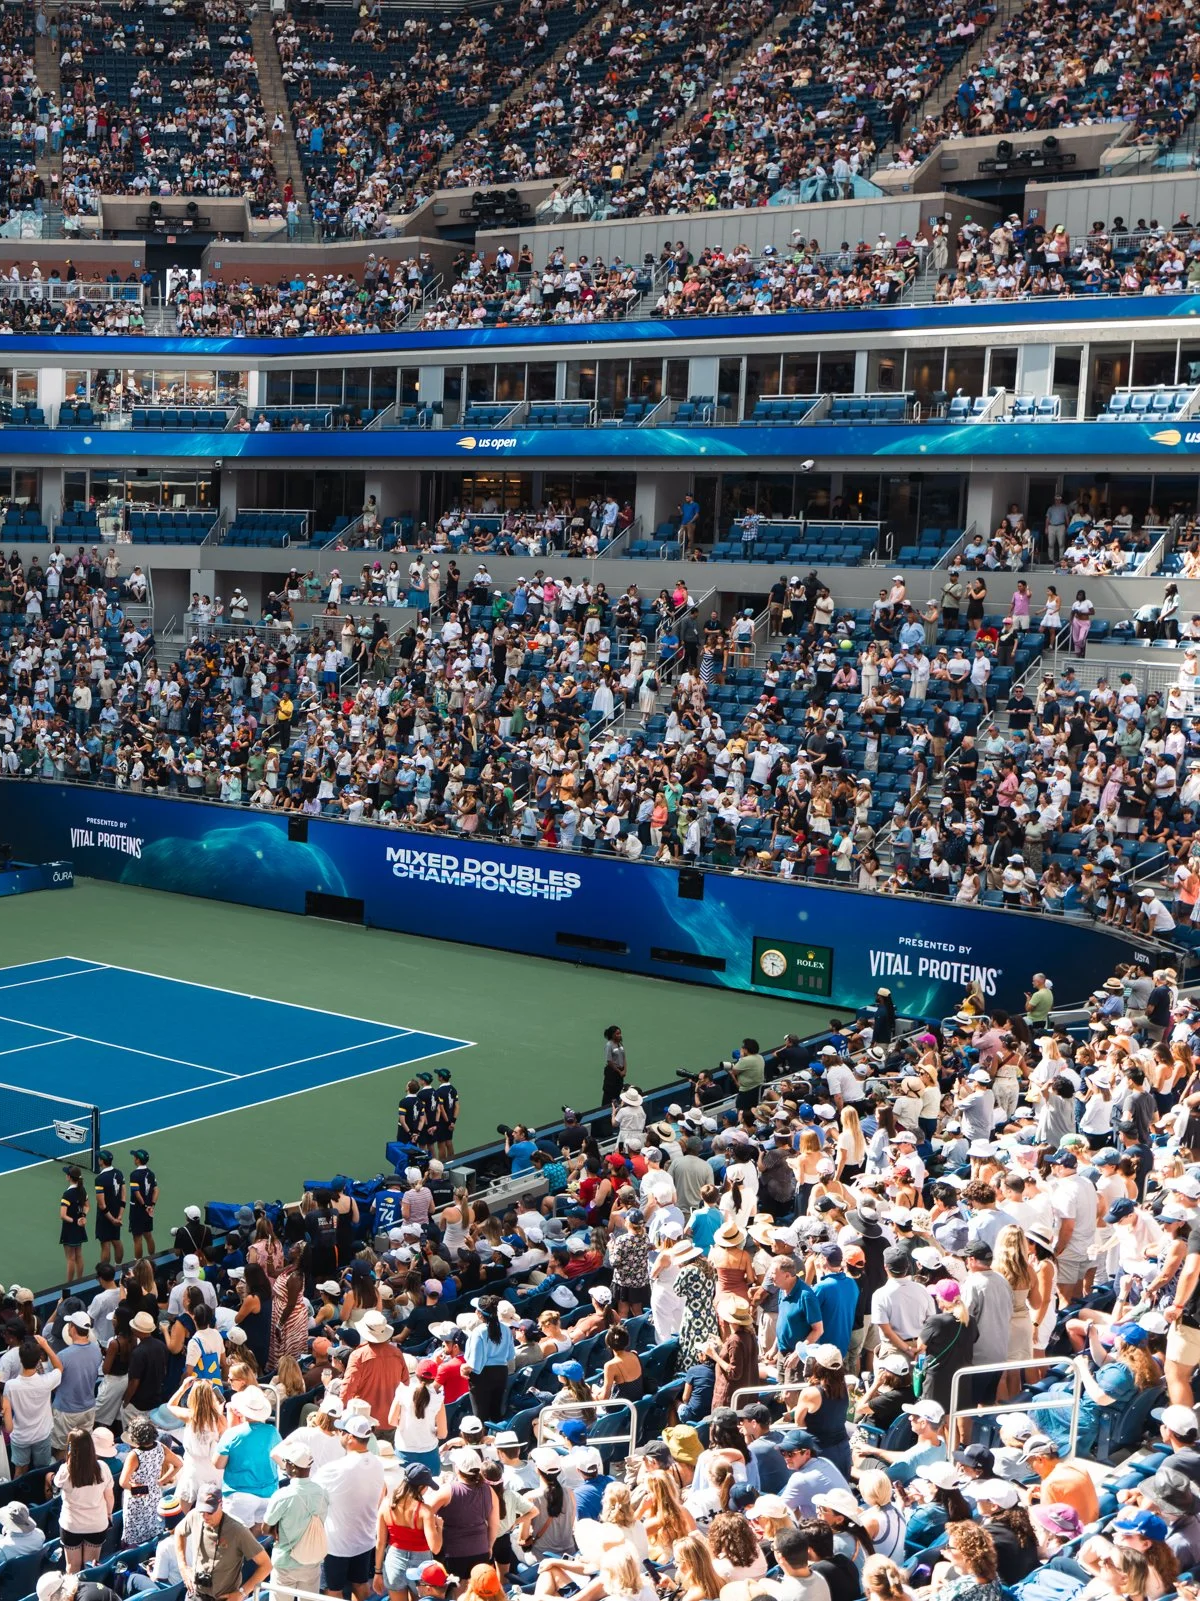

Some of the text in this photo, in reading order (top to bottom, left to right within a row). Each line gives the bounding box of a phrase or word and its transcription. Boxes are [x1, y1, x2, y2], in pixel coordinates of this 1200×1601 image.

[491, 438, 516, 450] open
[86, 817, 118, 828] PRESENTED
[70, 827, 95, 848] VITAL
[386, 847, 581, 889] MIXED DOUBLES
[392, 862, 573, 901] CHAMPIONSHIP
[899, 936, 972, 955] PRESENTED BY
[796, 959, 824, 969] ROLEX
[870, 950, 912, 976] VITAL
[1134, 952, 1150, 964] USTA
[379, 1207, 394, 1223] 74
